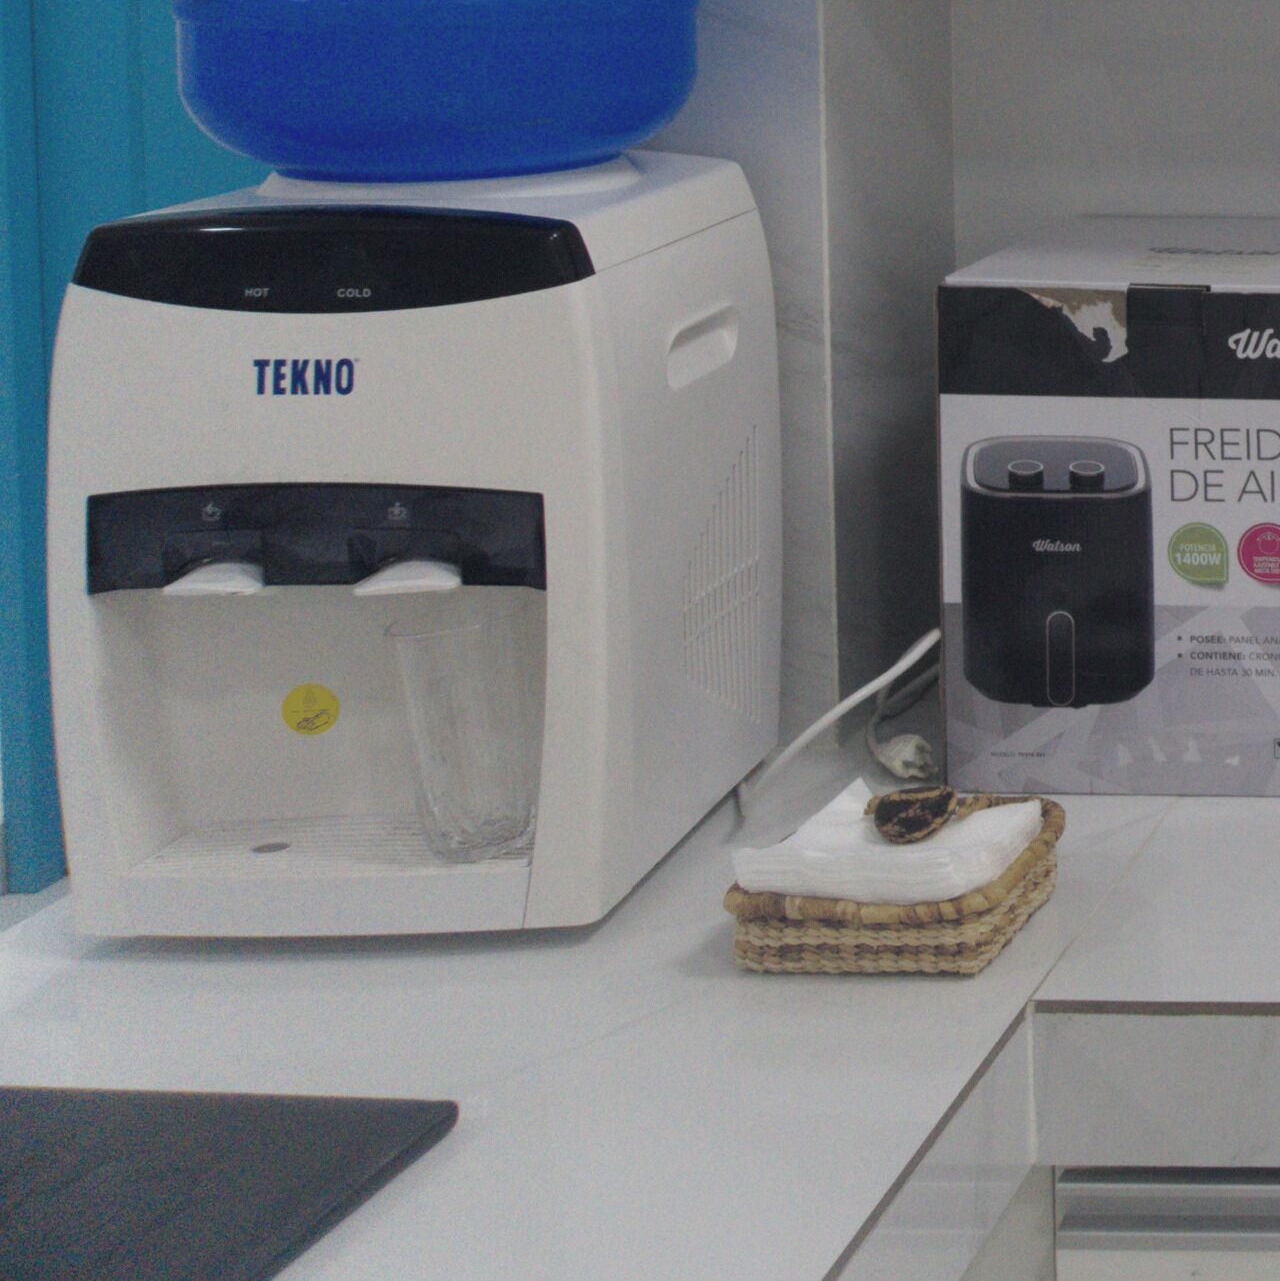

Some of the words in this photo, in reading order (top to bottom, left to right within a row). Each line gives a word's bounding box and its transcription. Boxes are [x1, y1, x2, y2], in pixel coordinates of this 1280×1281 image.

[244, 287, 270, 298] HOT
[337, 287, 372, 298] COLD
[253, 358, 355, 395] TEKNO
[1169, 469, 1226, 503] DE
[1032, 538, 1082, 552] Watson
[1175, 552, 1222, 566] 1400W
[1190, 635, 1226, 644] POSEE:
[1228, 636, 1259, 645] PANEL
[1189, 652, 1246, 661] CONTIENE:
[1190, 668, 1205, 677] DE
[1206, 668, 1238, 677] HASTA
[1241, 668, 1253, 677] 30
